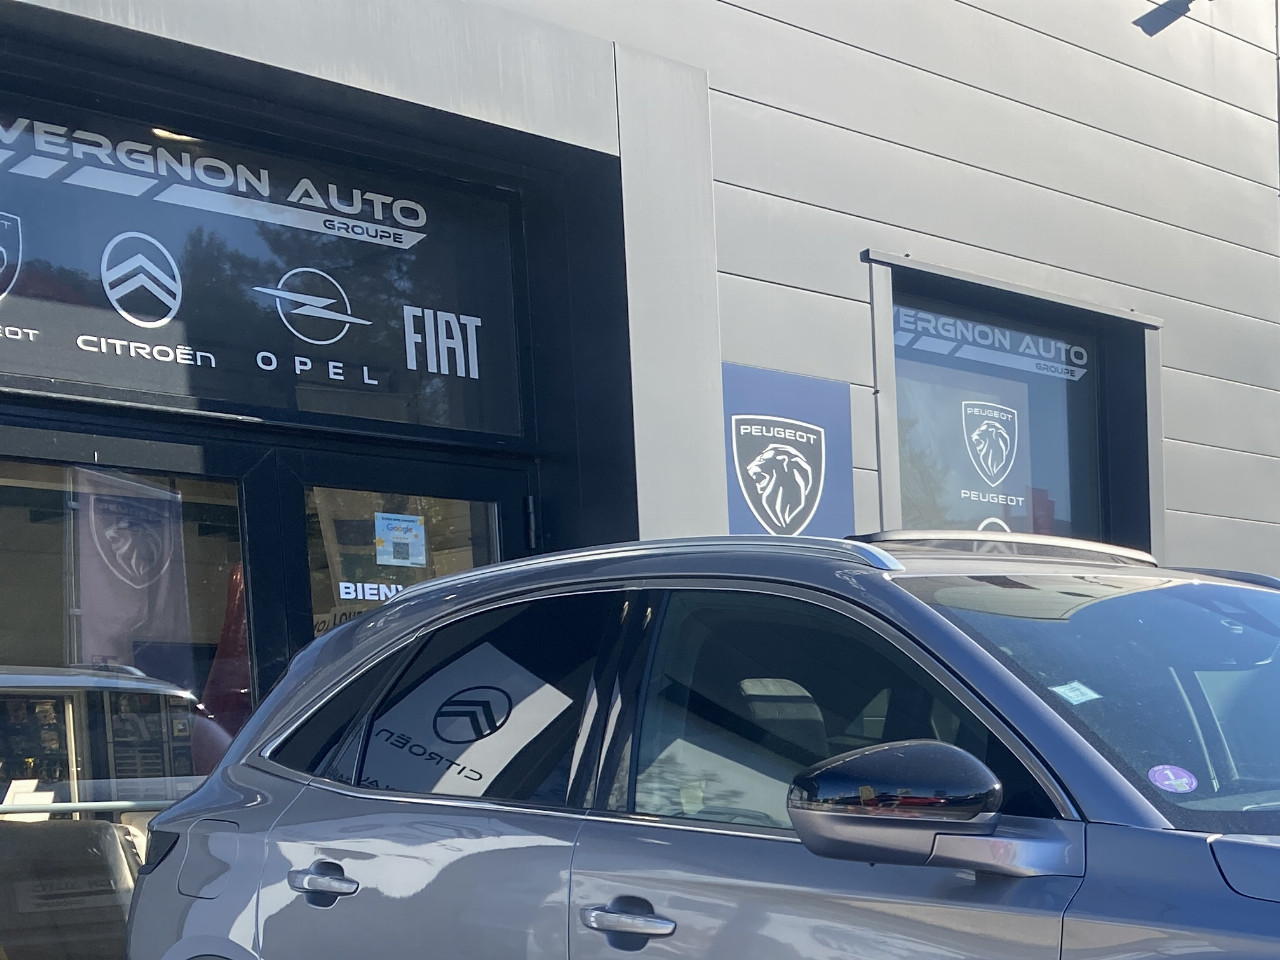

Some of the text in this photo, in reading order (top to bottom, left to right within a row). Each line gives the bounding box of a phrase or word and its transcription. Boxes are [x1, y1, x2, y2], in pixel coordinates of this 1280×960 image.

[287, 178, 427, 228] AUTO
[323, 219, 404, 244] GROUPE
[402, 305, 482, 380] FIAT
[893, 306, 1088, 366] ERGNON AUTO
[256, 351, 378, 385] OPEL
[1035, 362, 1076, 378] GROUPE
[967, 407, 1013, 421] PEUGEOT
[740, 425, 817, 444] PEUGEOT
[961, 489, 1025, 506] PEUGEOT
[386, 523, 413, 534] Google
[339, 581, 404, 601] BIEN
